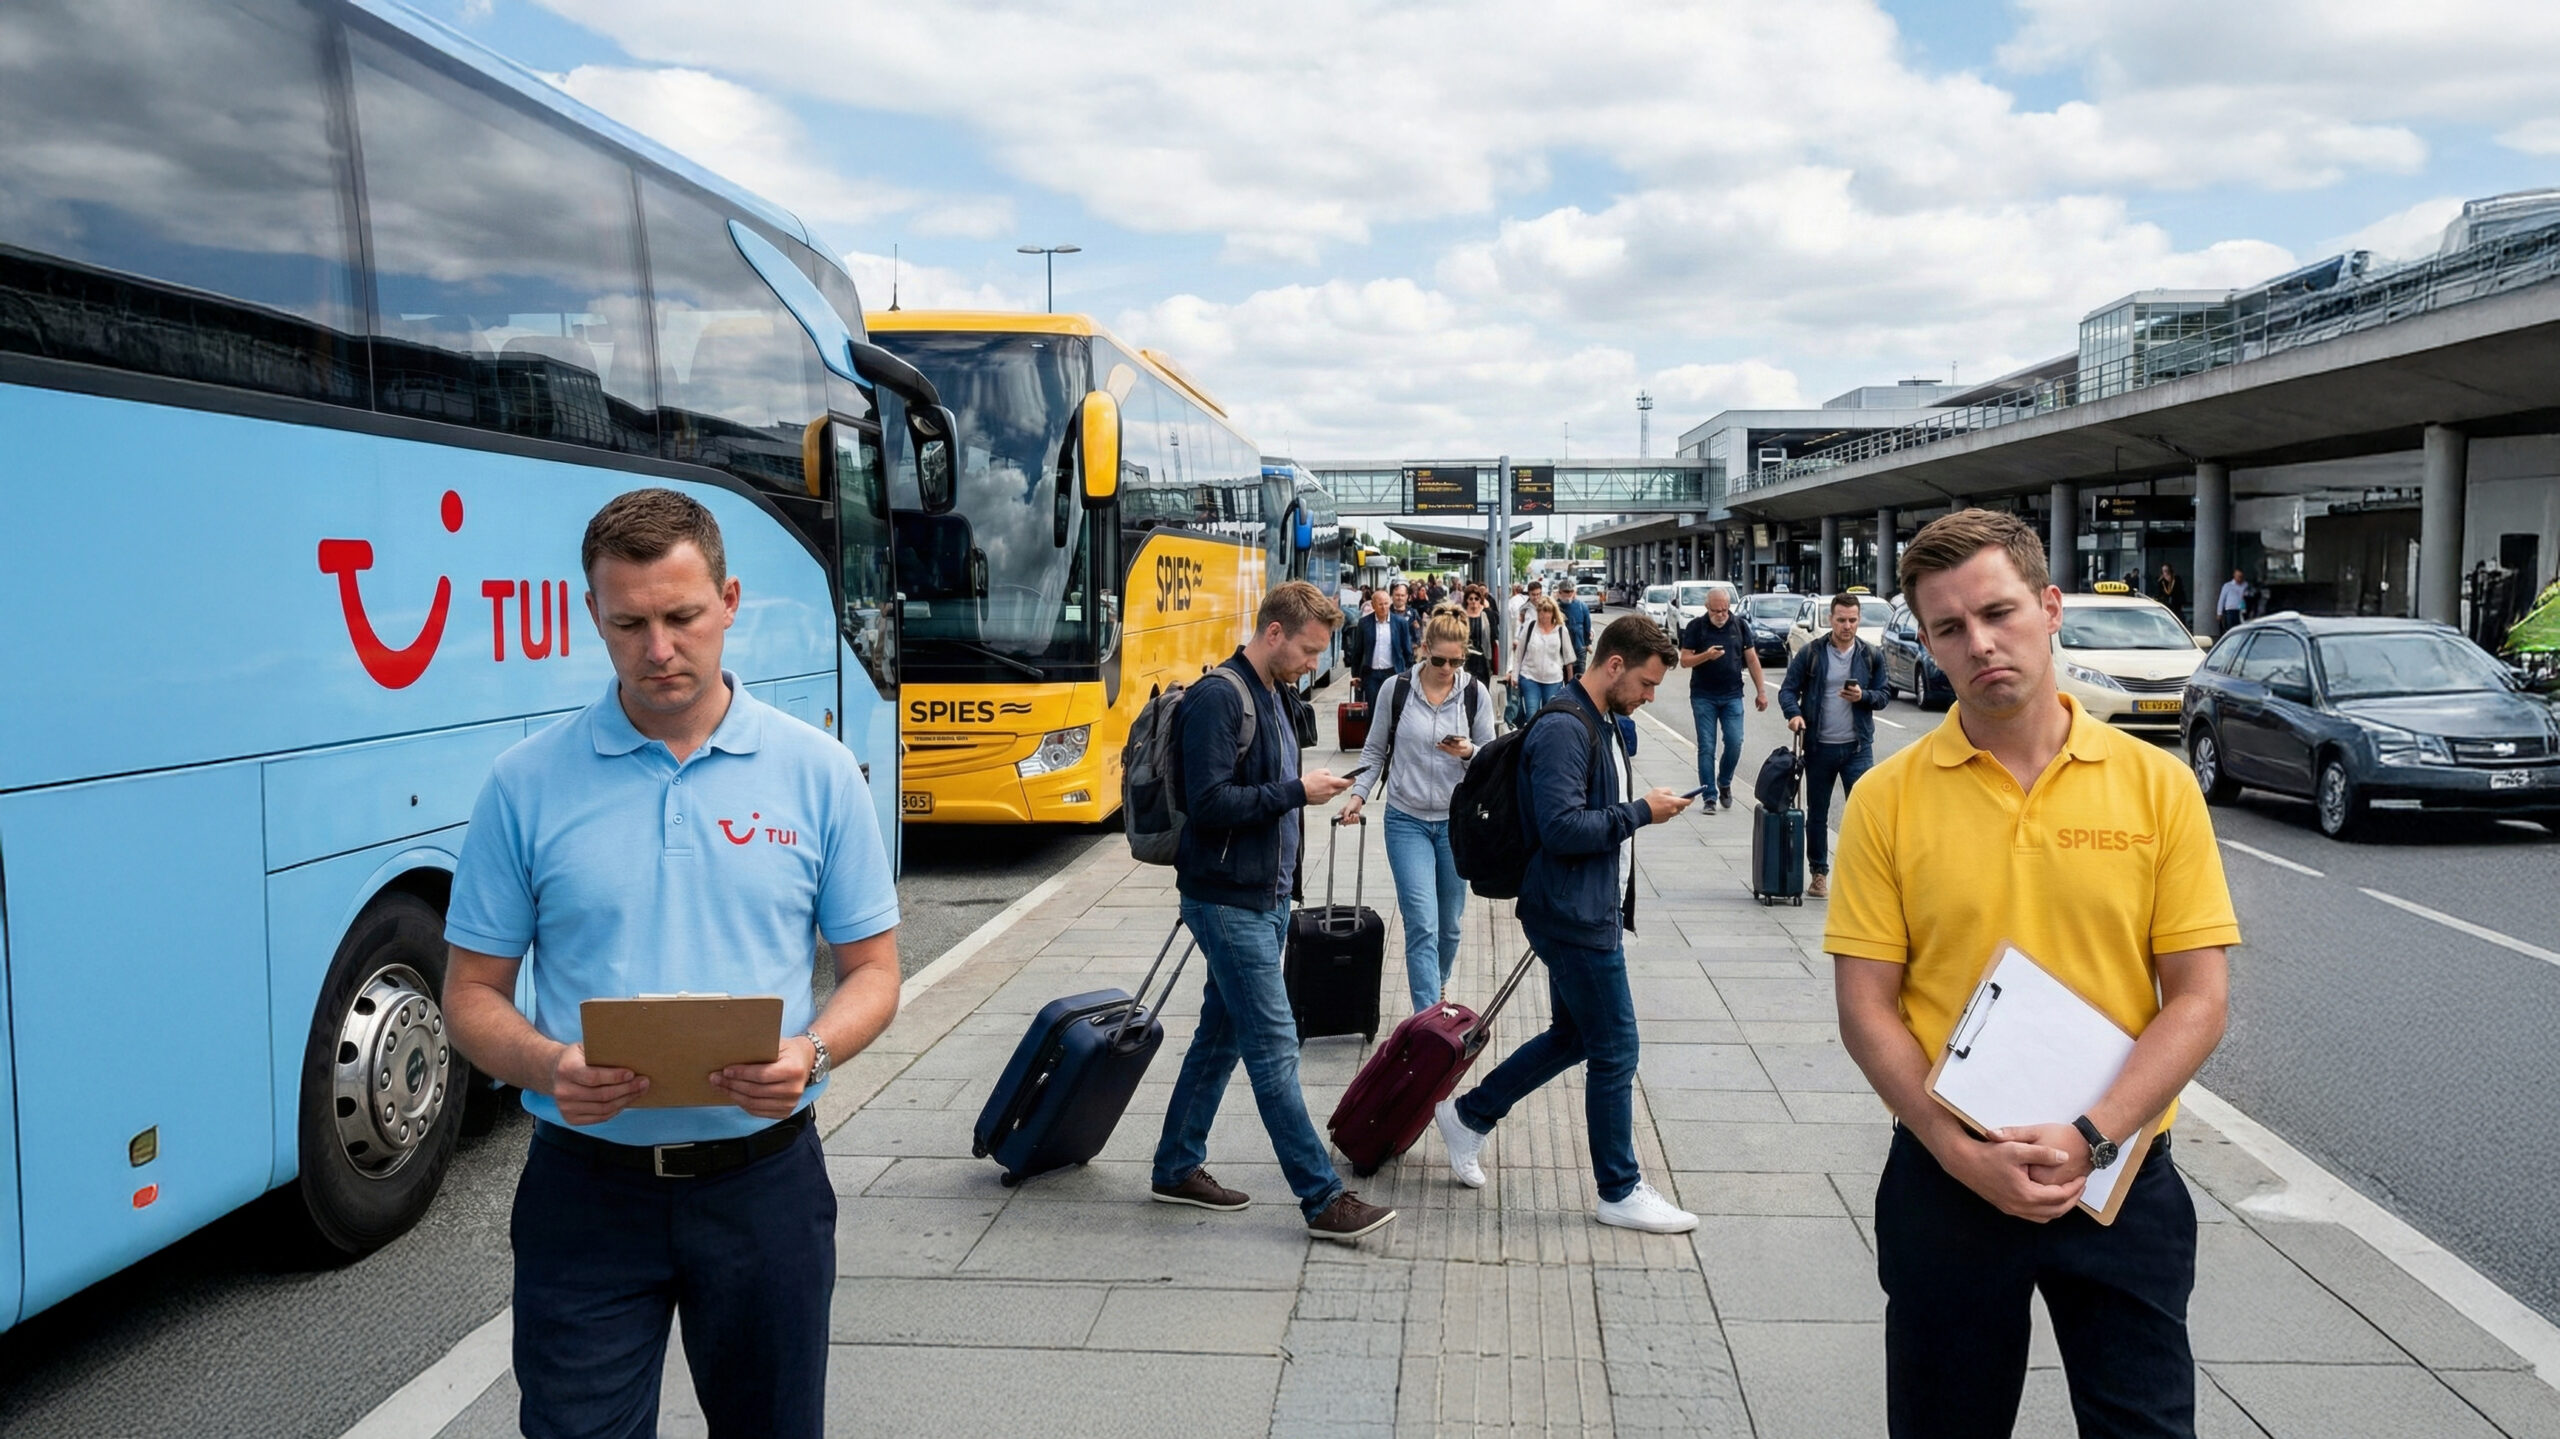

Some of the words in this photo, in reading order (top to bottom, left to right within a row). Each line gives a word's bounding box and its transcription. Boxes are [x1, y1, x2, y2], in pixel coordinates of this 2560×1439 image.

[1156, 554, 1191, 614] SPIES
[481, 579, 570, 662] TUI
[910, 700, 995, 723] SPIES
[765, 828, 797, 846] TUI
[2056, 828, 2130, 852] SPIES
